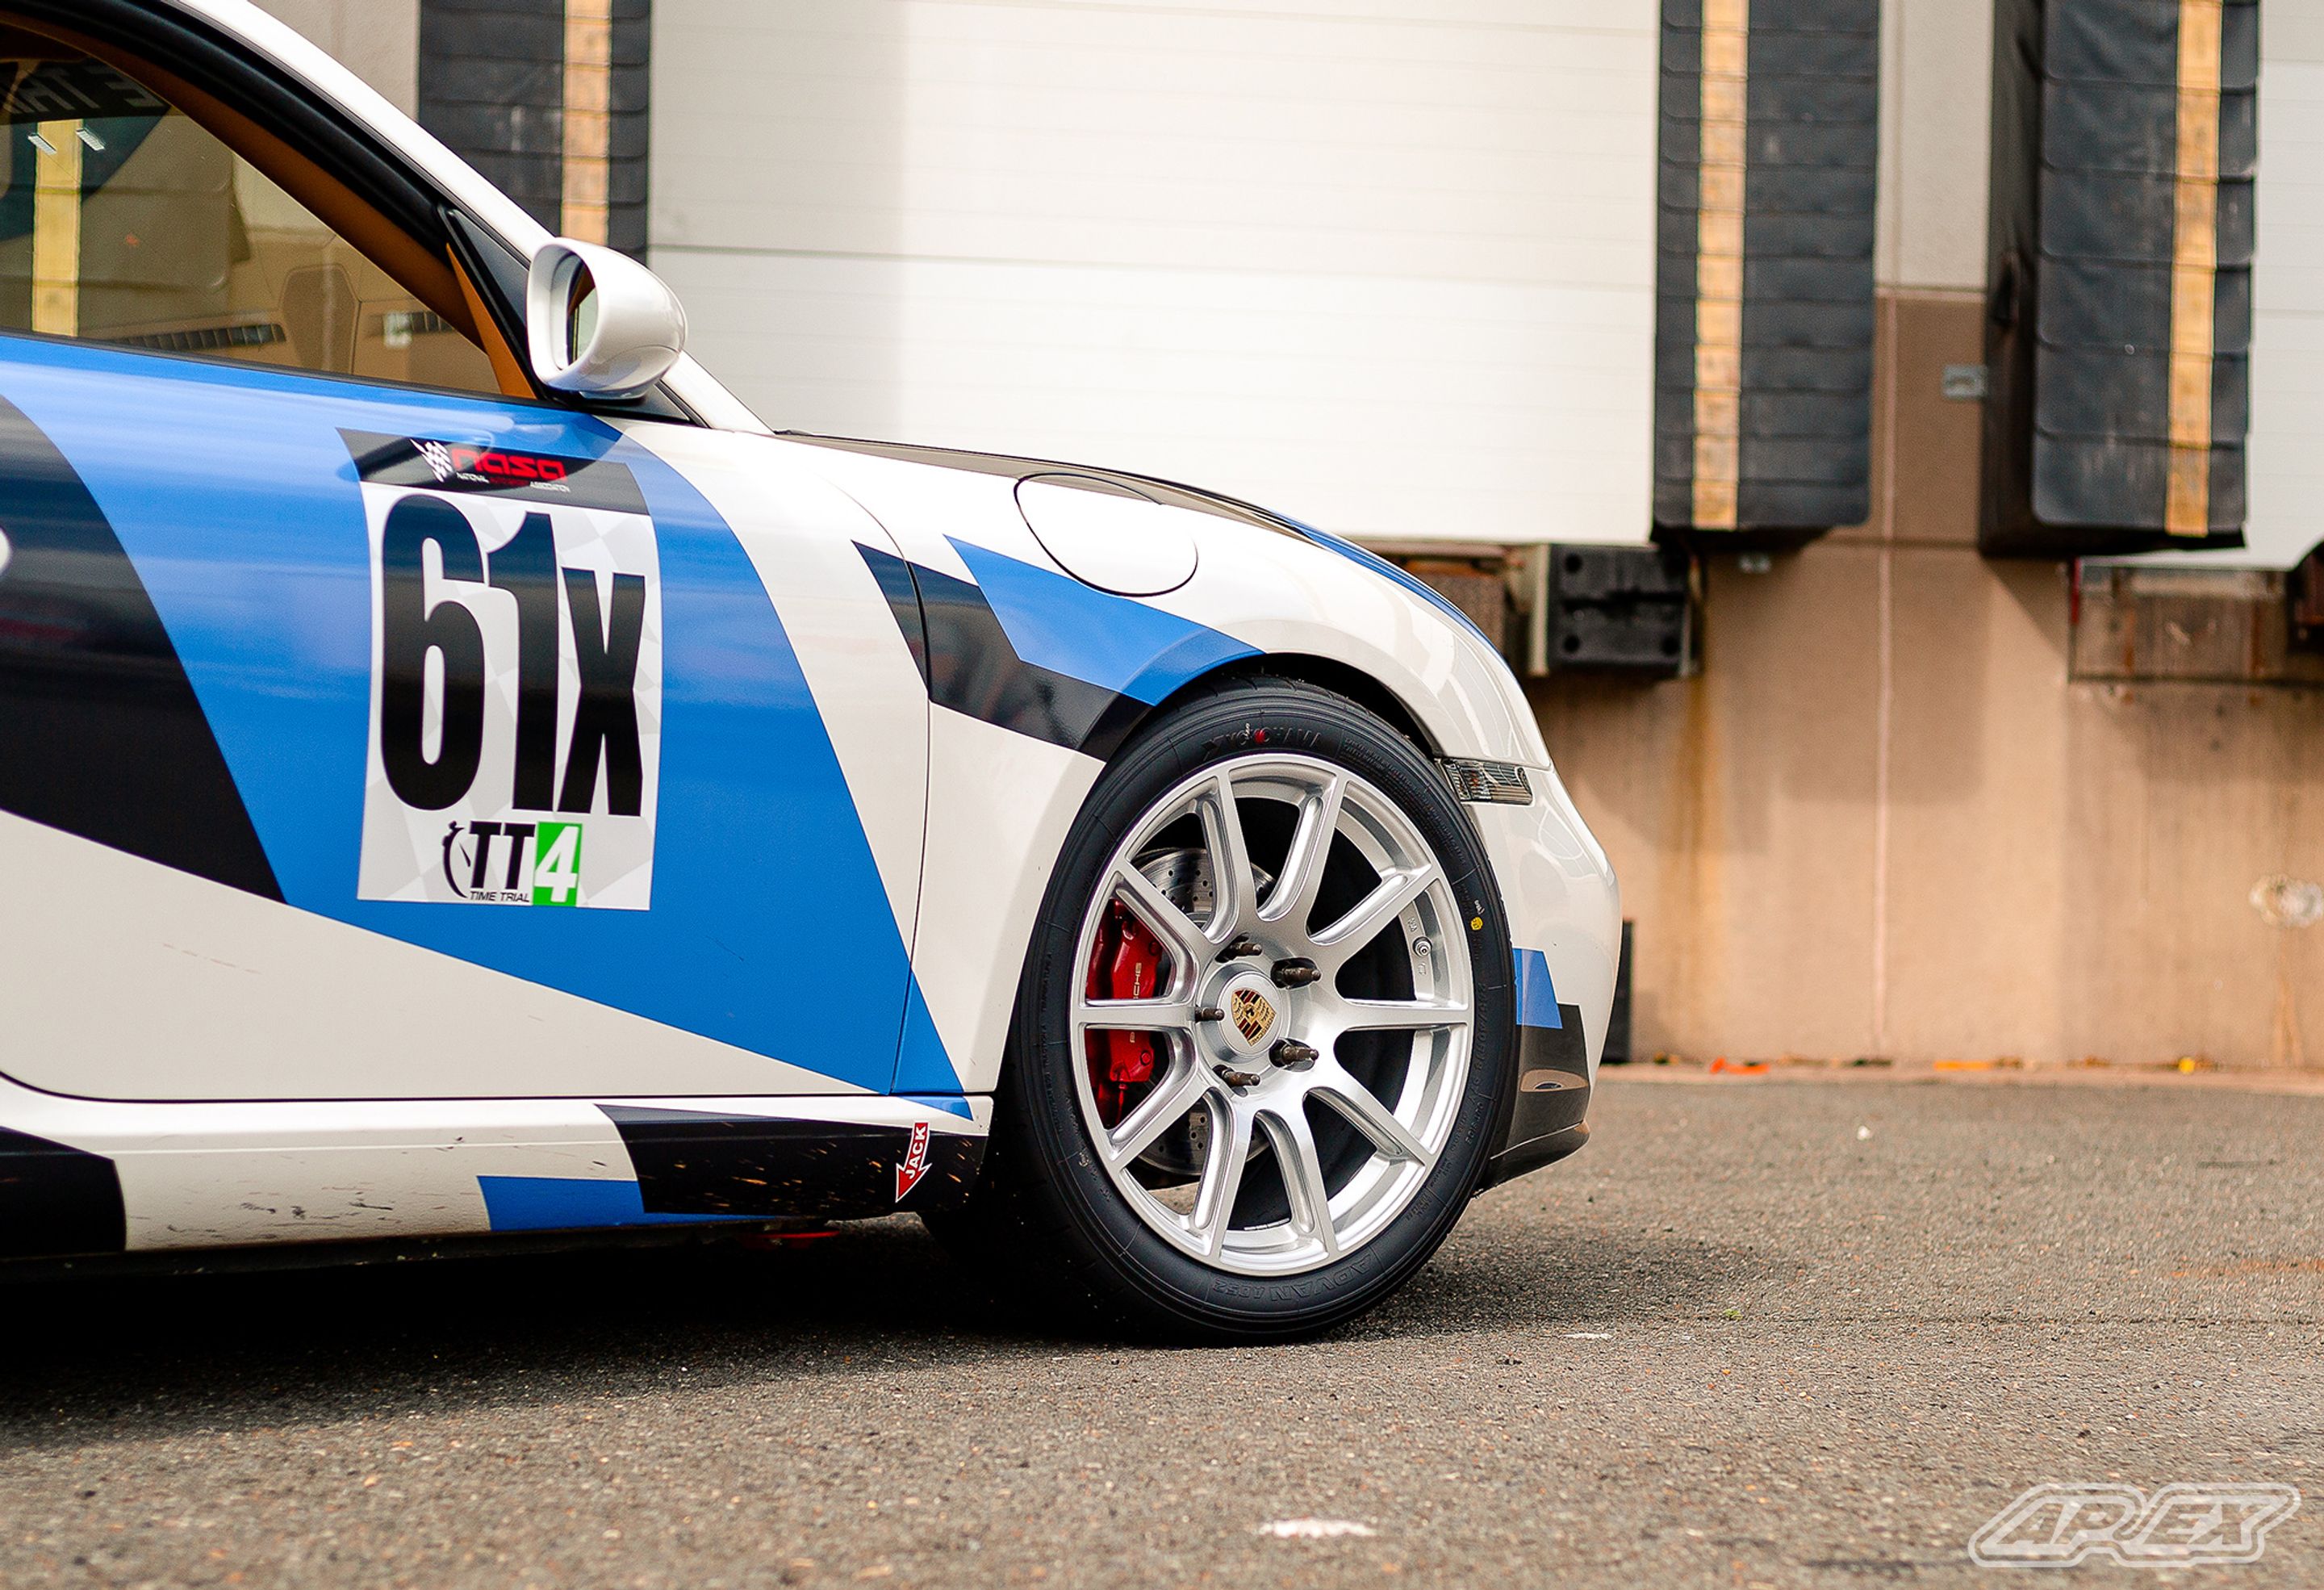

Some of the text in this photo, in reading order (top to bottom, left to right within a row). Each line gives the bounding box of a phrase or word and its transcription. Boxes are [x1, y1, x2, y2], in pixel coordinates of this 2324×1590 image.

[470, 891, 530, 903] TIME TRIAL
[905, 1126, 927, 1180] JACK
[1271, 1252, 1372, 1301] ADVAN
